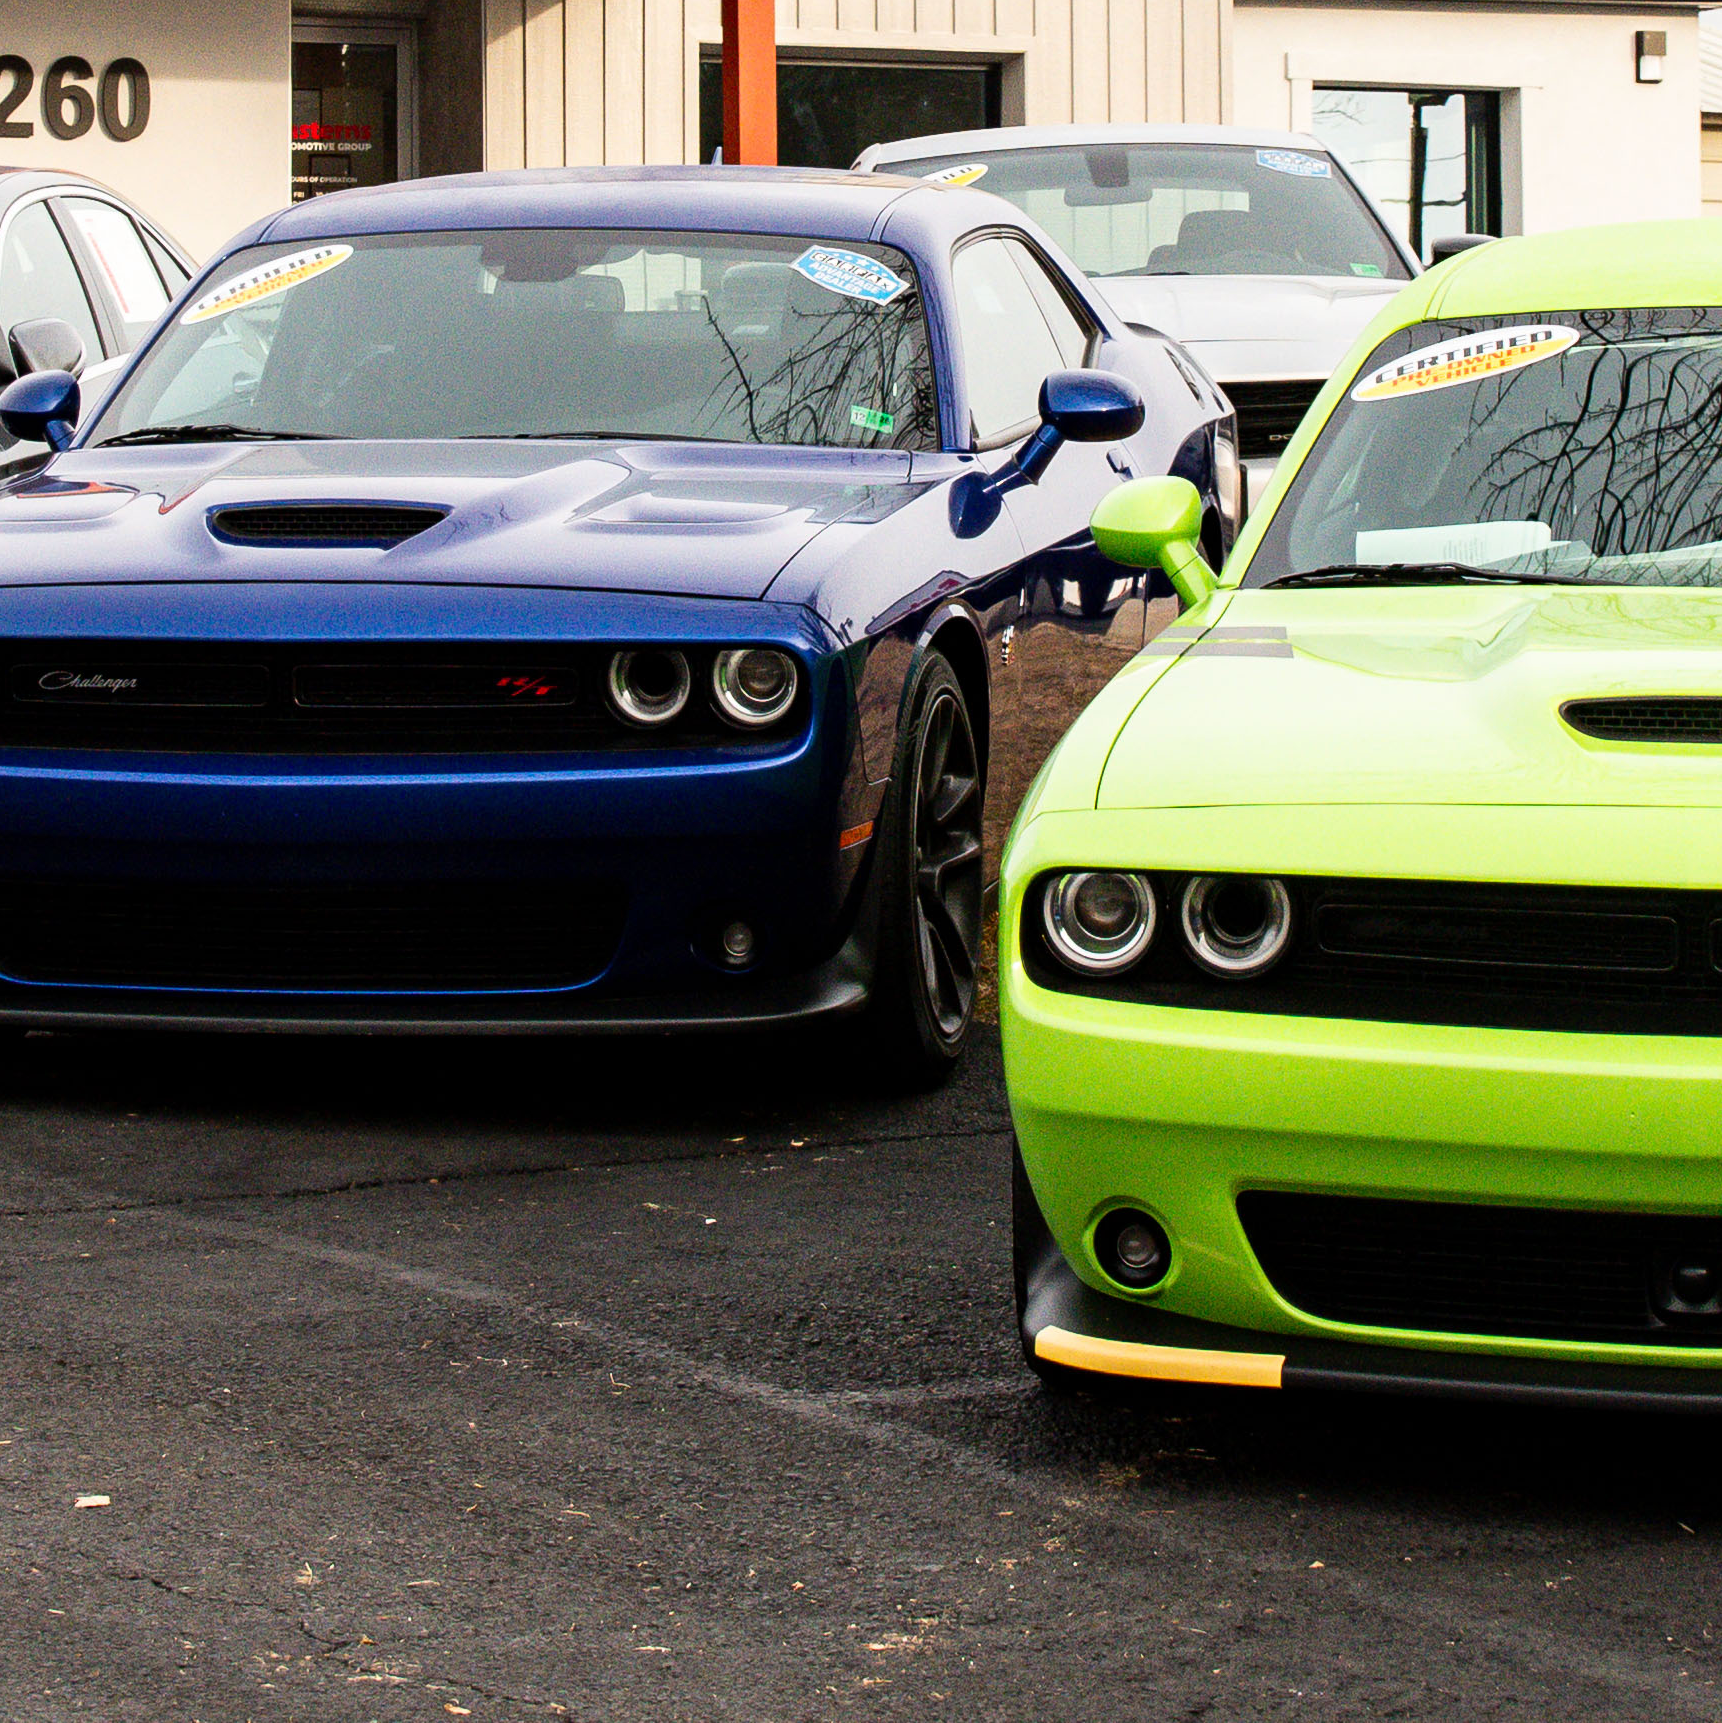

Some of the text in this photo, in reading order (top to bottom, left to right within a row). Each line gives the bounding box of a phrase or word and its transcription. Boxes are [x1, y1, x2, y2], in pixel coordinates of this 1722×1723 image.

[337, 142, 372, 151] GROUP
[1375, 330, 1553, 384] CERTIFIED
[1392, 345, 1536, 387] PRE-OWNED
[1415, 357, 1513, 387] VEHICLE
[38, 670, 138, 693] Challenger
